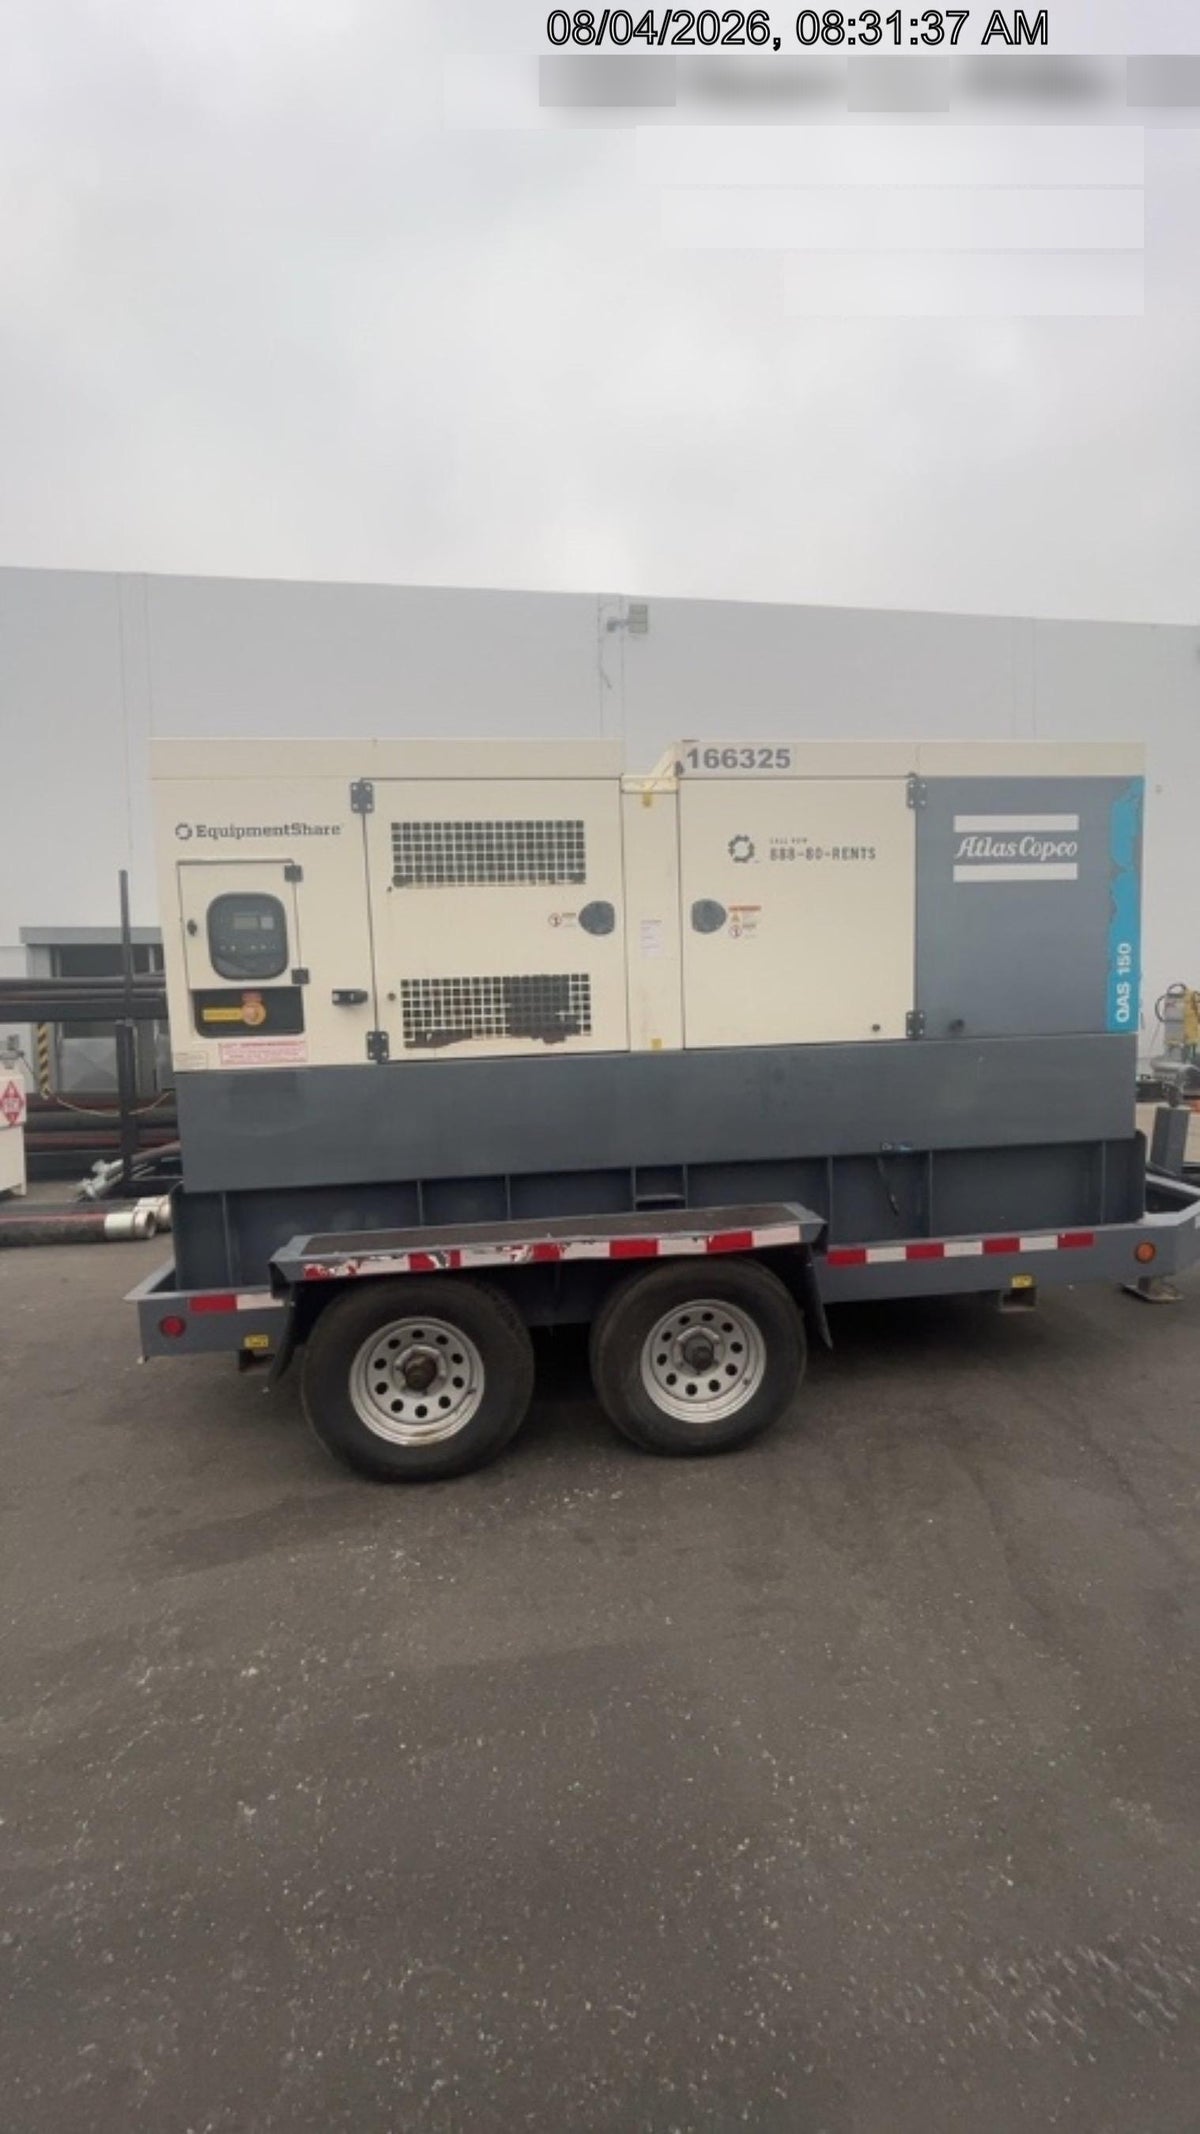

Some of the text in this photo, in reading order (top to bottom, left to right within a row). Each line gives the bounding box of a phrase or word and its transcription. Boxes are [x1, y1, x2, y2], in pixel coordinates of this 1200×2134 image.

[687, 748, 791, 769] 166325
[196, 822, 342, 840] EquipmentShare
[1116, 943, 1132, 1023] QAS 150
